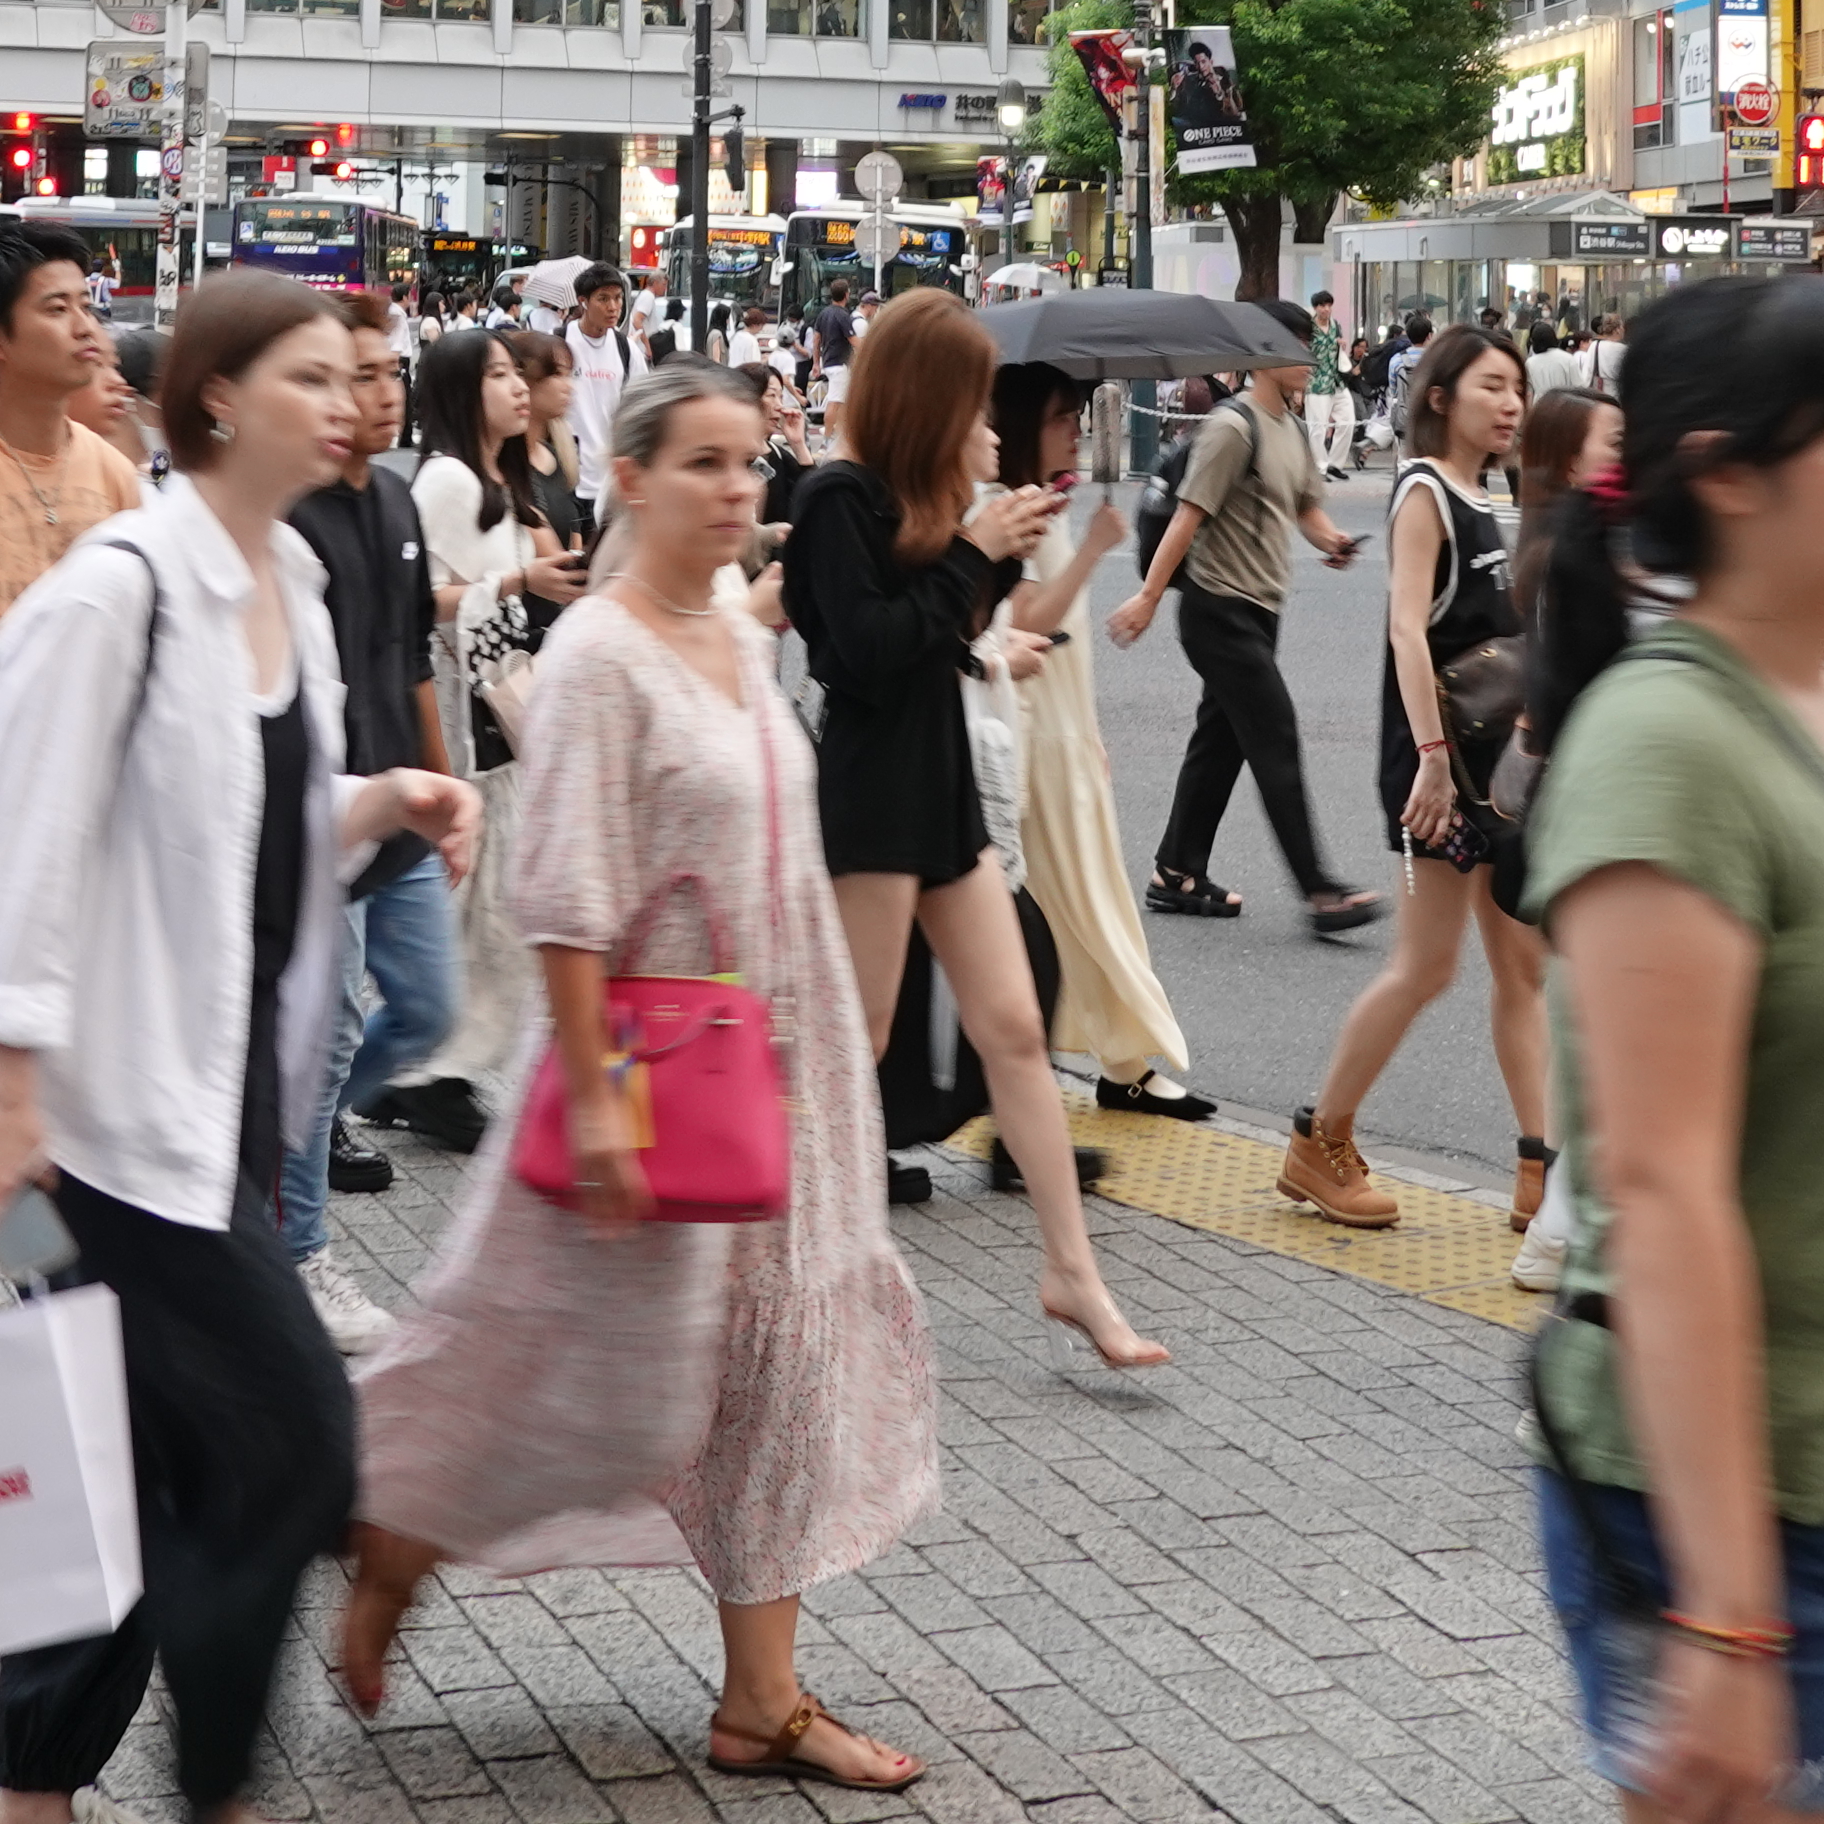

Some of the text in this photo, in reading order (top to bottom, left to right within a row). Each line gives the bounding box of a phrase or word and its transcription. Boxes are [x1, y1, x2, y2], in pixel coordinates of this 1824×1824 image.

[1738, 93, 1770, 110] 消火栓
[1182, 125, 1244, 143] ONE PIECE
[297, 244, 320, 255] BUS
